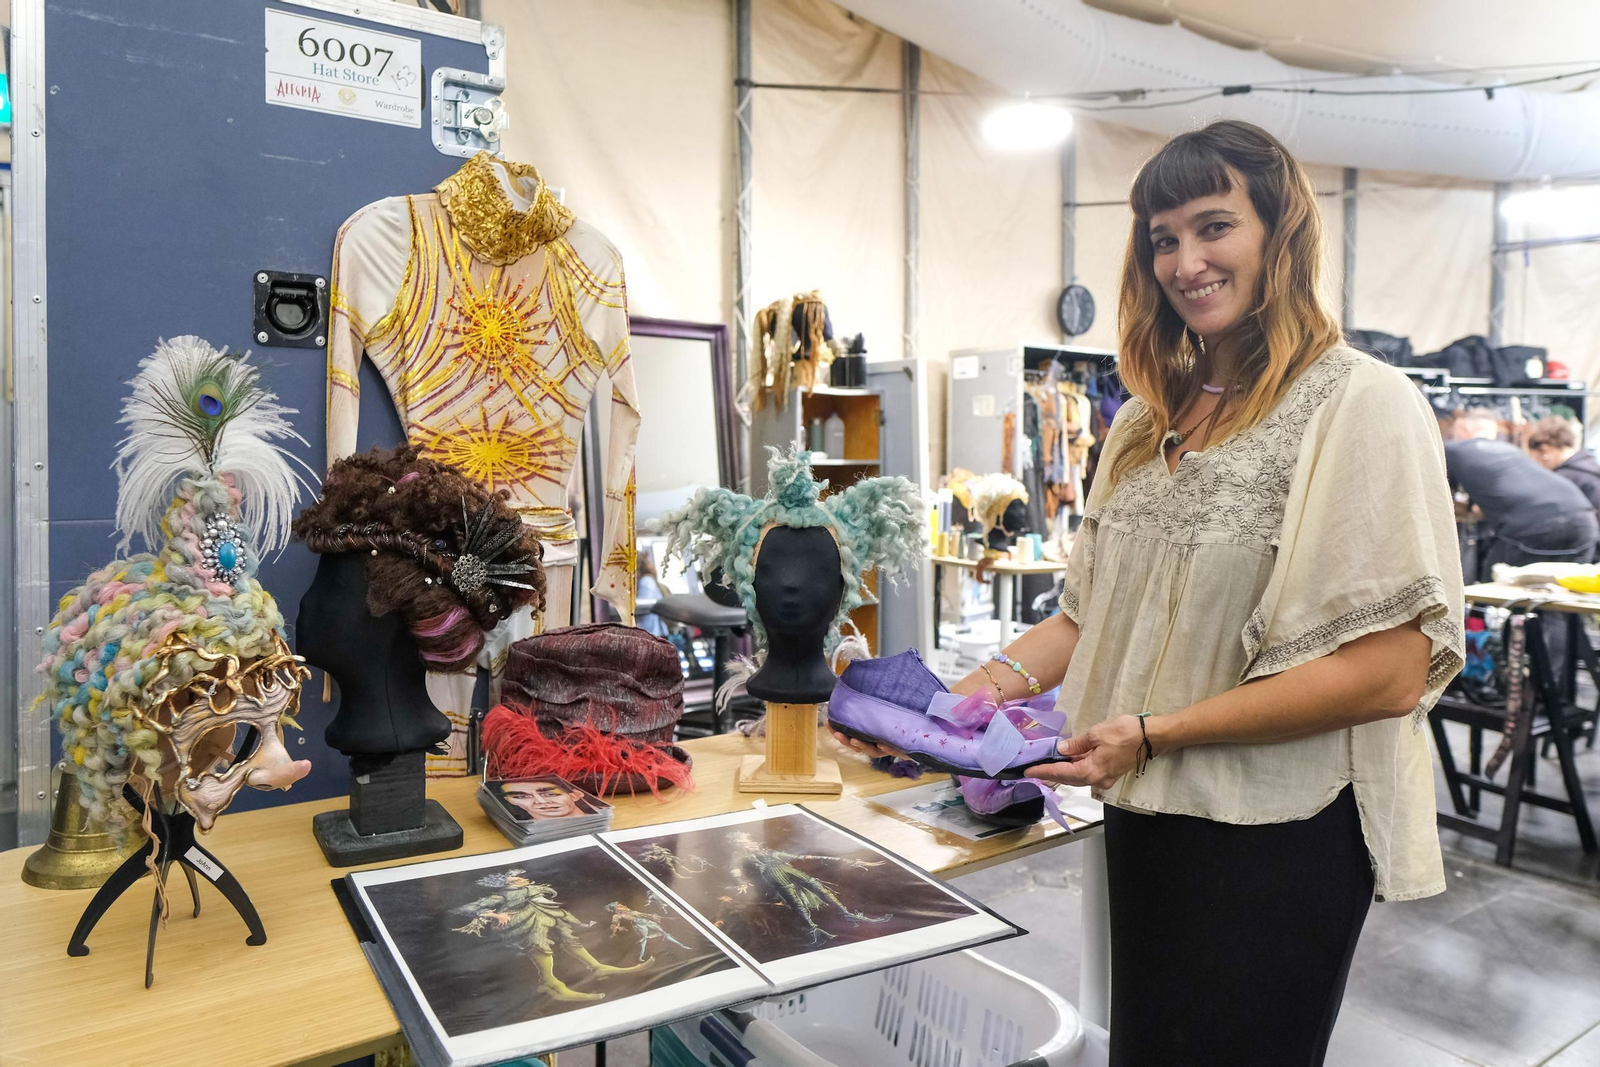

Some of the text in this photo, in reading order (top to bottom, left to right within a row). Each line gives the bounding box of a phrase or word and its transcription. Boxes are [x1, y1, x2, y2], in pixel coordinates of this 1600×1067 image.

[298, 27, 394, 77] 6007
[313, 62, 380, 86] Hat Store
[391, 65, 417, 91] 153
[375, 100, 415, 113] Wardrobe
